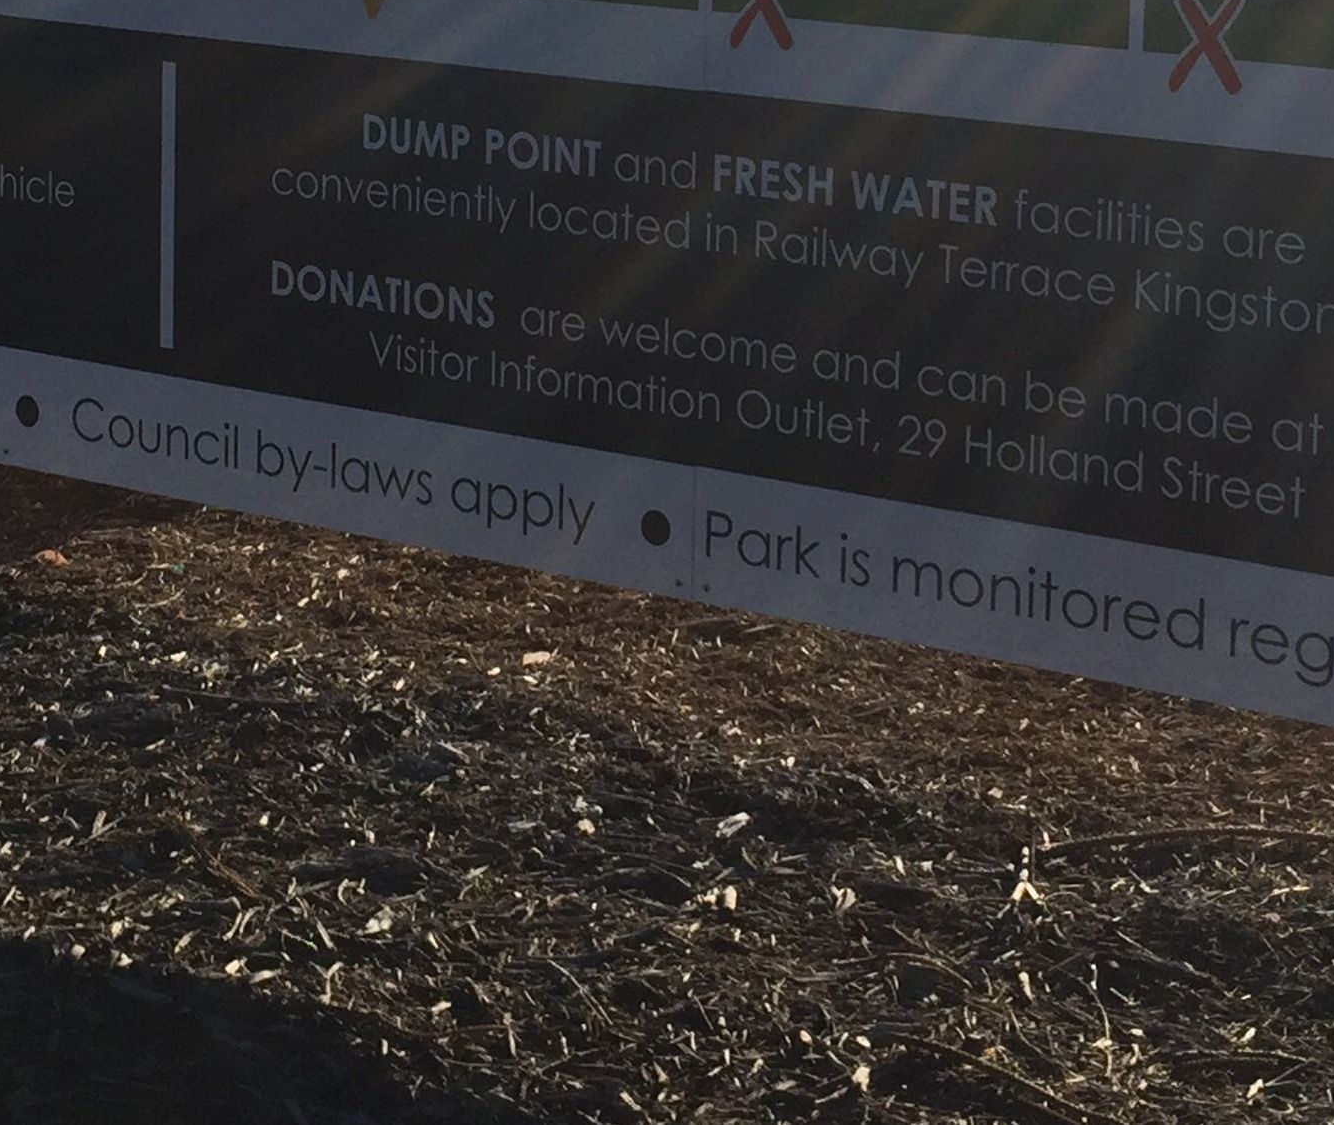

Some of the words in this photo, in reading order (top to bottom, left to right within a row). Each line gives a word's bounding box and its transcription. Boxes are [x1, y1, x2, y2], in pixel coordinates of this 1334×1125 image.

[271, 166, 516, 234] conveniently
[528, 191, 690, 250] located
[705, 213, 738, 256] in
[754, 220, 924, 289] Railway
[938, 243, 1117, 307] Terrace
[362, 113, 470, 162] DUMP
[484, 126, 602, 177] POINT
[614, 149, 697, 189] and
[712, 153, 835, 207] FRESH
[851, 171, 998, 227] WATER
[1014, 190, 1204, 254] facilities
[1223, 222, 1306, 265] are
[270, 259, 496, 329] DONATIONS
[519, 304, 586, 344] are
[598, 315, 797, 373] welcome
[813, 343, 901, 393] and
[917, 365, 1008, 407] can
[1025, 372, 1087, 420] be
[1104, 391, 1253, 446] made
[1271, 414, 1325, 457] at
[368, 330, 480, 383] Visitor
[491, 351, 721, 424] Information
[736, 388, 883, 456] Outlet,
[897, 411, 948, 462] 29
[964, 424, 1144, 494] Holland
[1160, 454, 1307, 521] Street
[71, 397, 241, 470] Council
[256, 420, 435, 507] by-laws
[450, 474, 596, 543] apply
[704, 510, 821, 579] Park
[839, 532, 872, 588] is
[892, 553, 1206, 652] monitored
